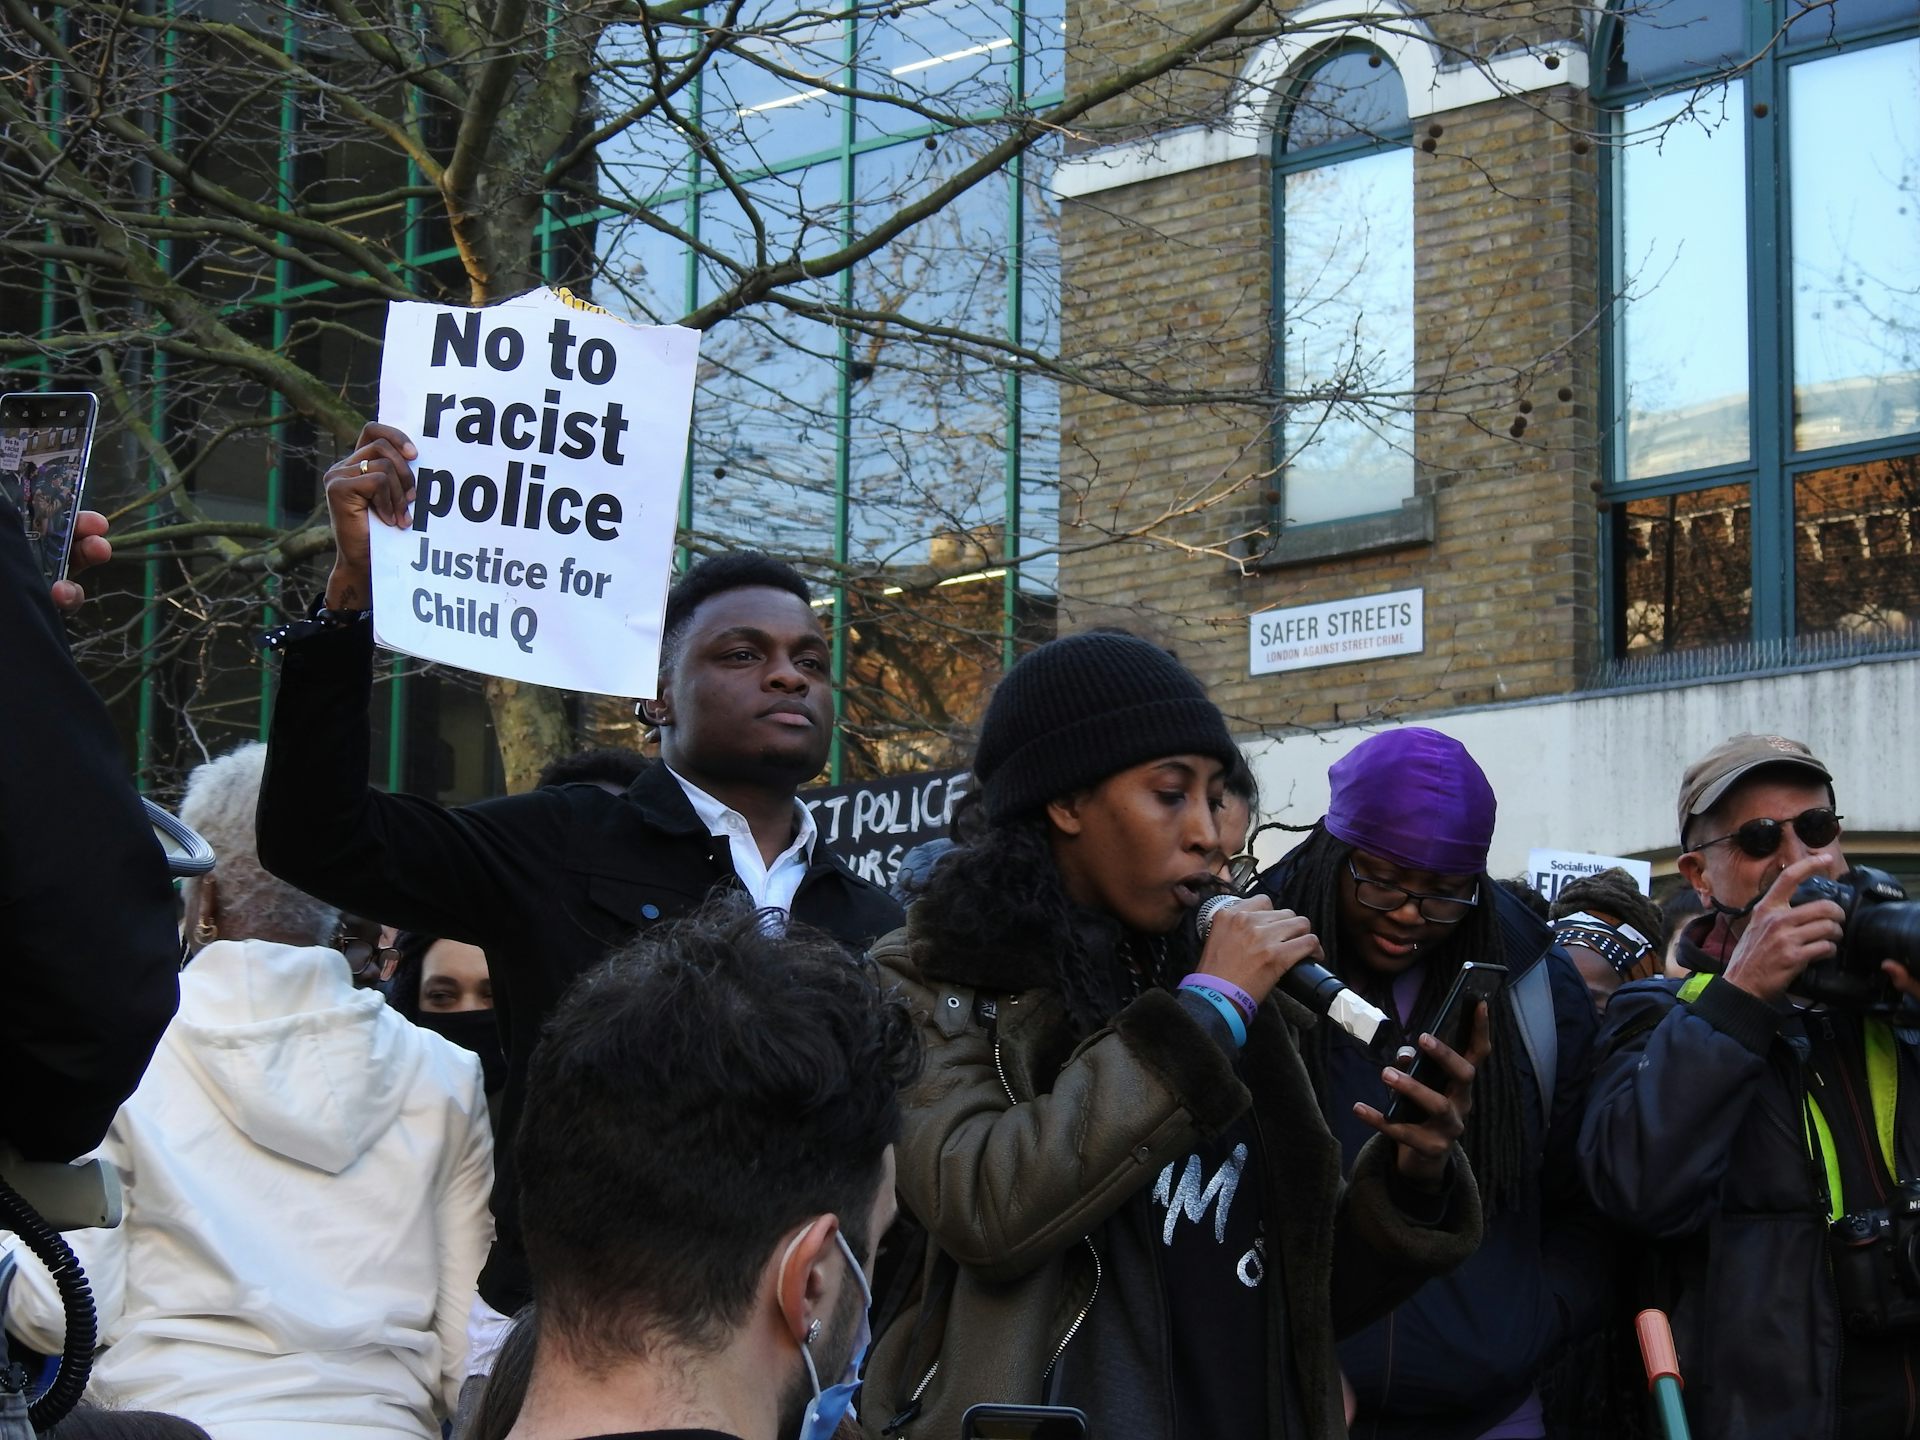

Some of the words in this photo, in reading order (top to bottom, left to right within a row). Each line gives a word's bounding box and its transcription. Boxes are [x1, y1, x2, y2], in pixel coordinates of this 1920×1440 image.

[430, 311, 525, 373] No
[548, 318, 617, 385] to
[422, 388, 629, 466] racist
[411, 460, 623, 542] police
[410, 537, 548, 591] Justice
[559, 557, 612, 599] for
[411, 587, 499, 640] Child
[510, 606, 539, 654] Q
[1260, 617, 1318, 647] SAFER
[1327, 602, 1412, 637] STREETS
[1266, 647, 1300, 664] LONDON
[1302, 642, 1340, 657] AGAINST
[1342, 637, 1374, 652] STREET
[1376, 633, 1404, 648] CRIME
[1550, 859, 1593, 873] Socialist
